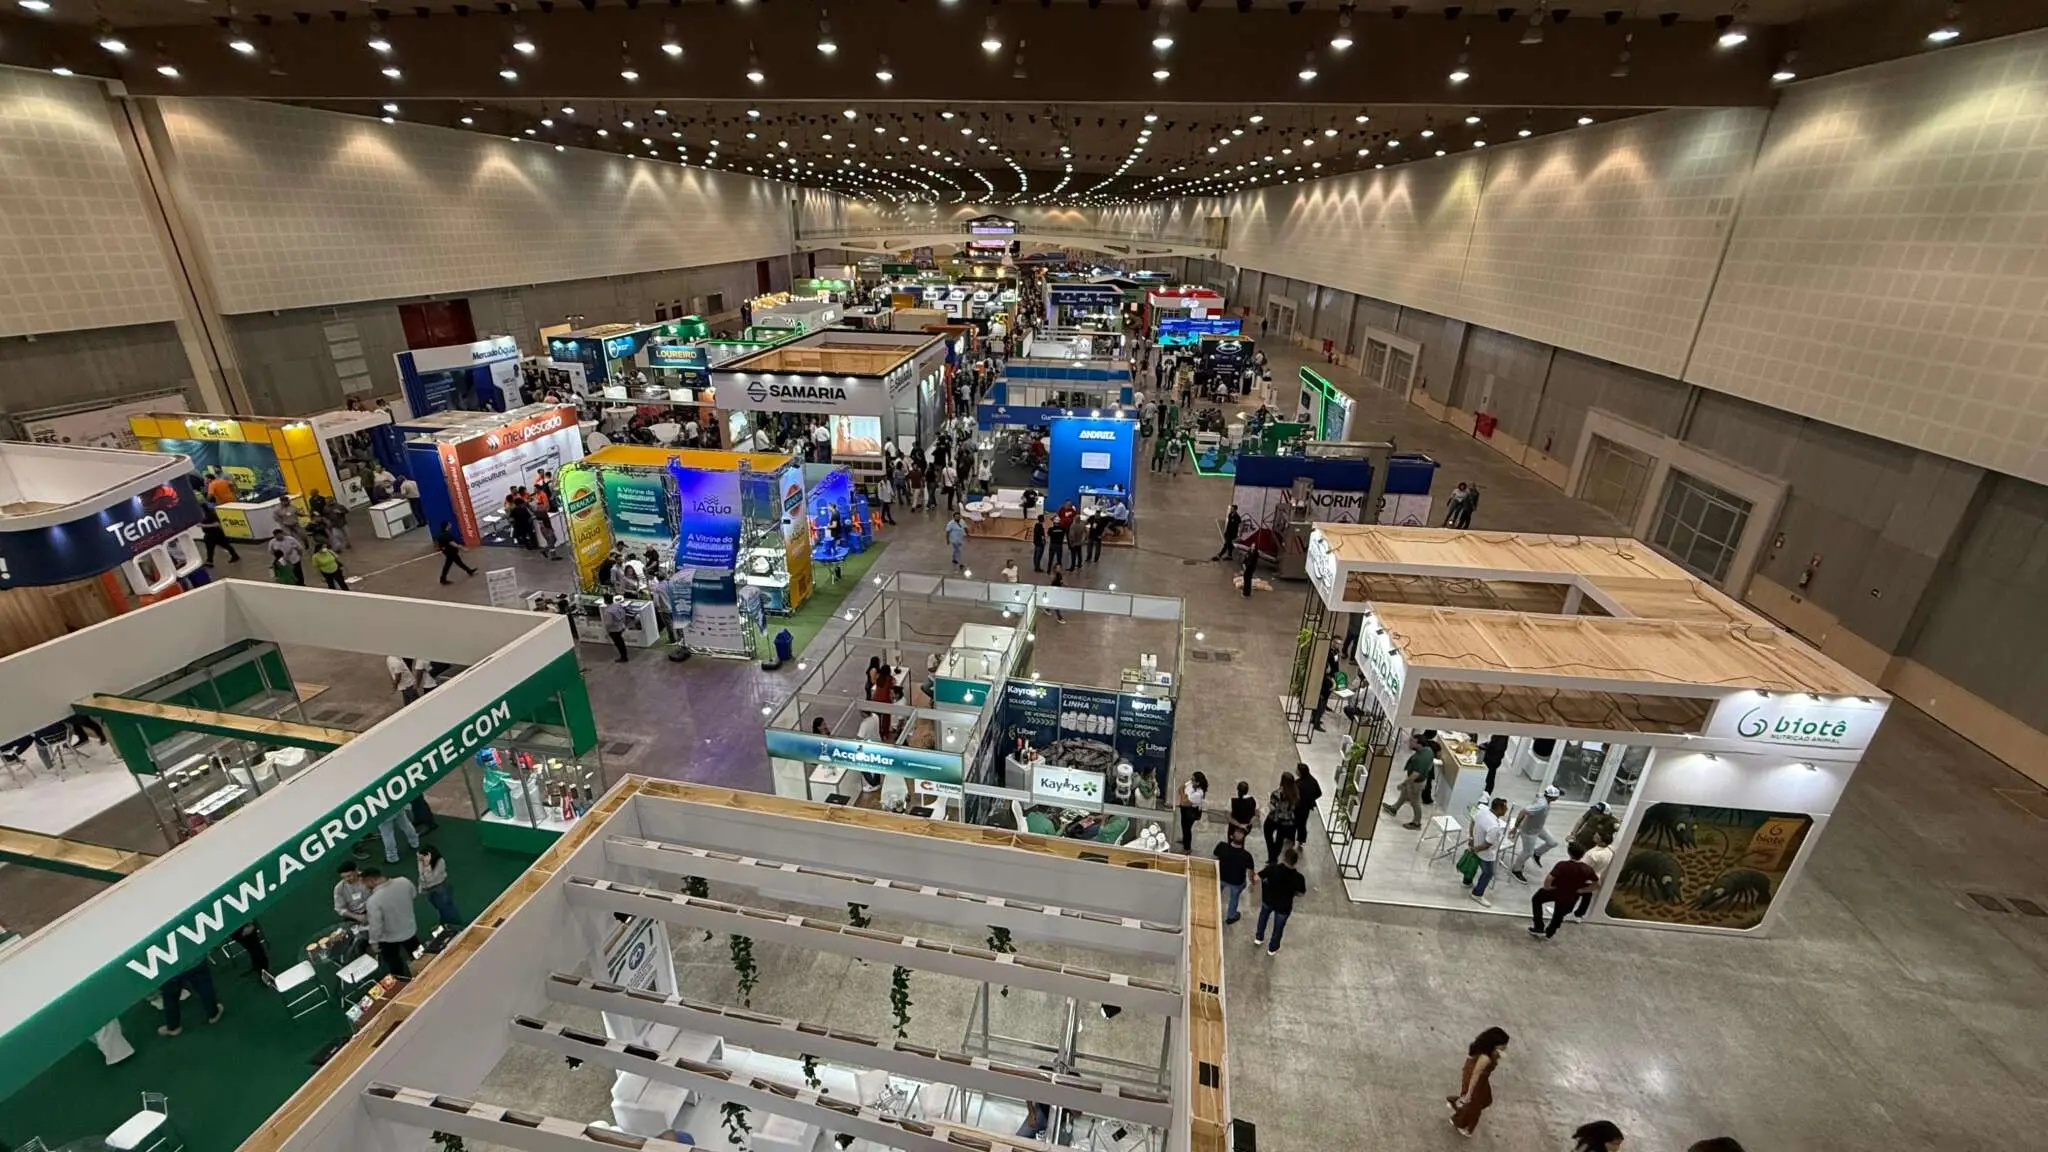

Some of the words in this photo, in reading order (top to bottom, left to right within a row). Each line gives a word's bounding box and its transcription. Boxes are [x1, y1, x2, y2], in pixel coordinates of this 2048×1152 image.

[655, 350, 697, 359] LOUREIRO
[769, 384, 847, 400] SAMARIA
[502, 416, 562, 446] meupescado
[1079, 430, 1116, 440] ANDRITZ
[692, 501, 732, 516] iAqua
[695, 534, 721, 543] Vitrine
[1062, 701, 1090, 709] LINHA
[1774, 716, 1848, 737] biotê
[125, 700, 512, 981] WWW.AGRONORTE.COM
